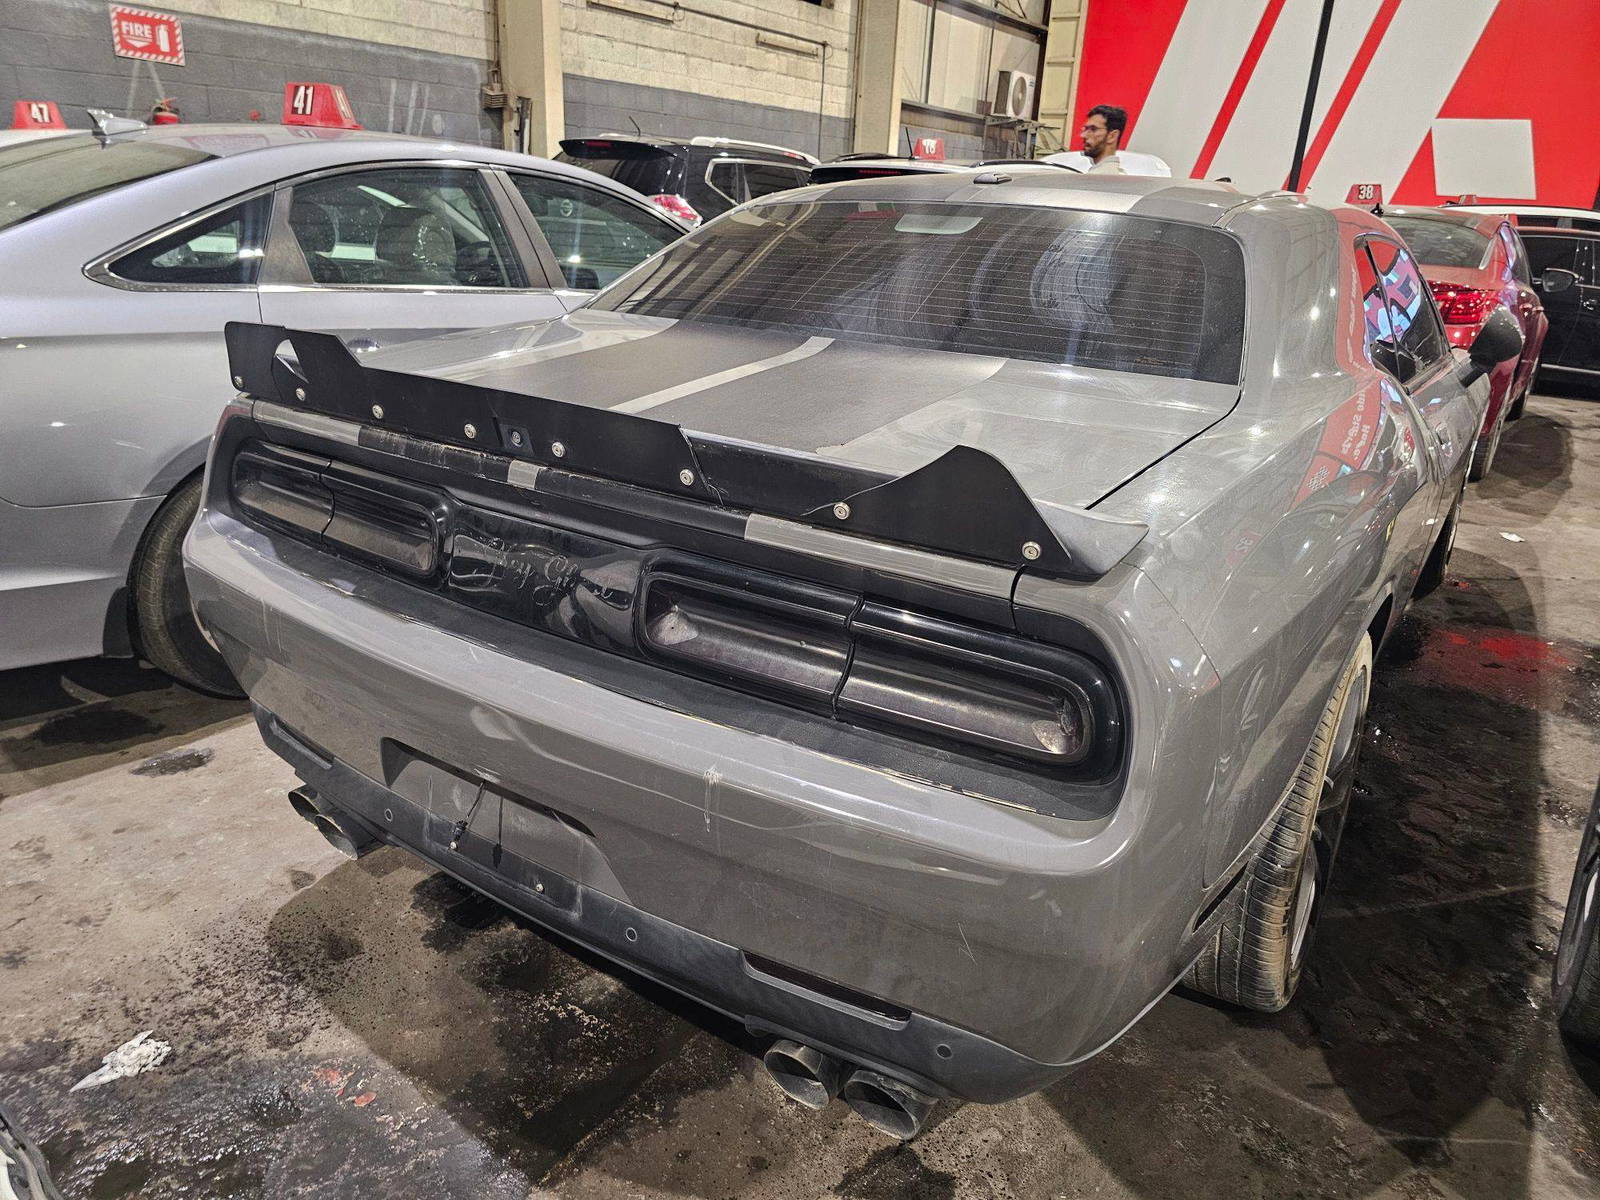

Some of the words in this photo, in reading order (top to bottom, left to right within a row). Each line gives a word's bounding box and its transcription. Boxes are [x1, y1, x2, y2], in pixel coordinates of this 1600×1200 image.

[120, 21, 153, 38] FIRE
[293, 85, 314, 115] 41
[31, 103, 50, 123] 47
[1358, 184, 1374, 199] 38
